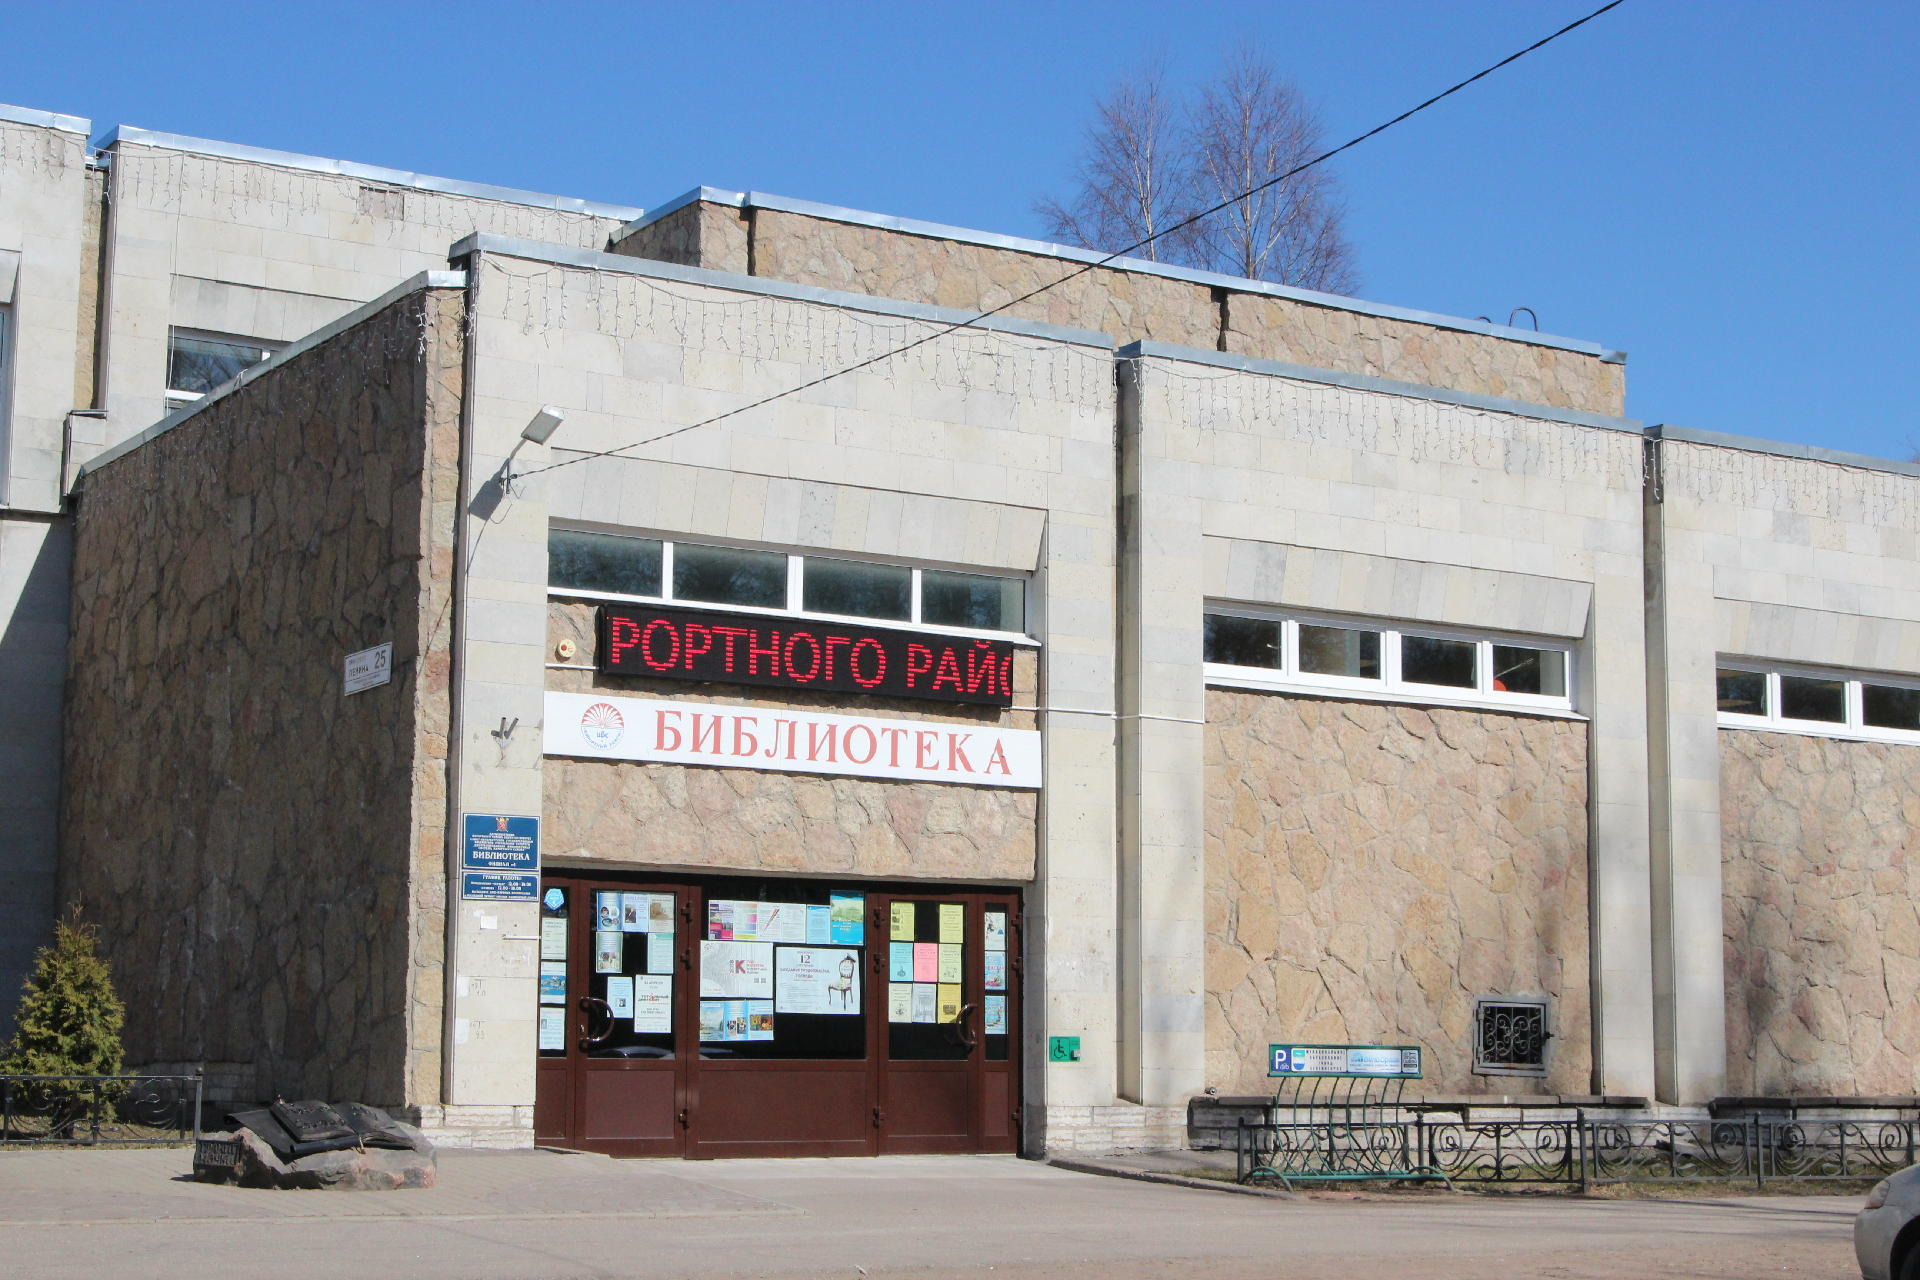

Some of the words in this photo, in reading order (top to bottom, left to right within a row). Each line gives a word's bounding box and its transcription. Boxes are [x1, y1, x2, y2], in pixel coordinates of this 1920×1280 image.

[374, 649, 386, 669] 25
[611, 616, 887, 688] РОРТНОГО
[654, 709, 1012, 775] БИБЛИОТЕКА
[473, 851, 530, 861] БИБЛИОТЕКА
